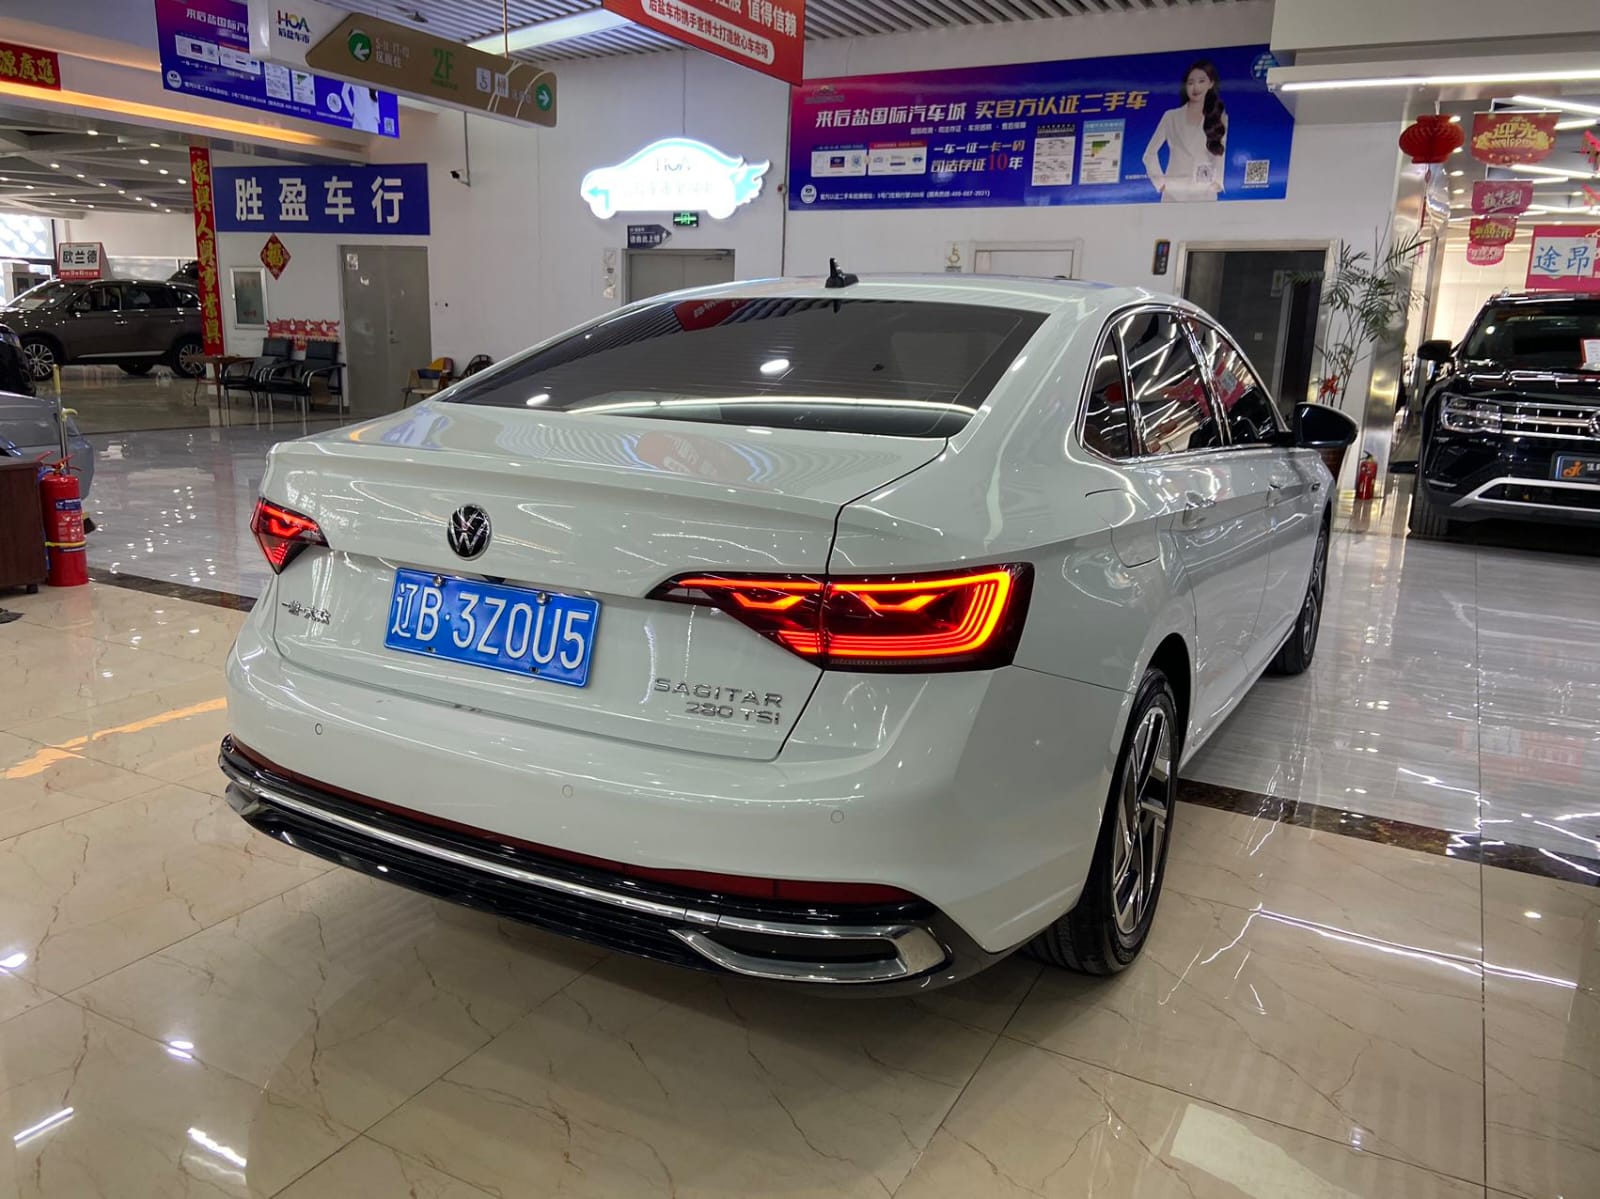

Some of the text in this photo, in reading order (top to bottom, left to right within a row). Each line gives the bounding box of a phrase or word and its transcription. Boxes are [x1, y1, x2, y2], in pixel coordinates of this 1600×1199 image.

[277, 10, 311, 33] HOA
[748, 0, 797, 38] 值得信赖
[433, 48, 454, 80] 2F
[815, 90, 1150, 128] 来后盐国际汽车城 买官方认证二手车
[235, 175, 404, 224] 胜盈车行
[63, 249, 97, 264] 欧兰德
[1533, 245, 1590, 274] 途昂
[654, 678, 783, 708] SAGITAR
[685, 702, 734, 719] 280
